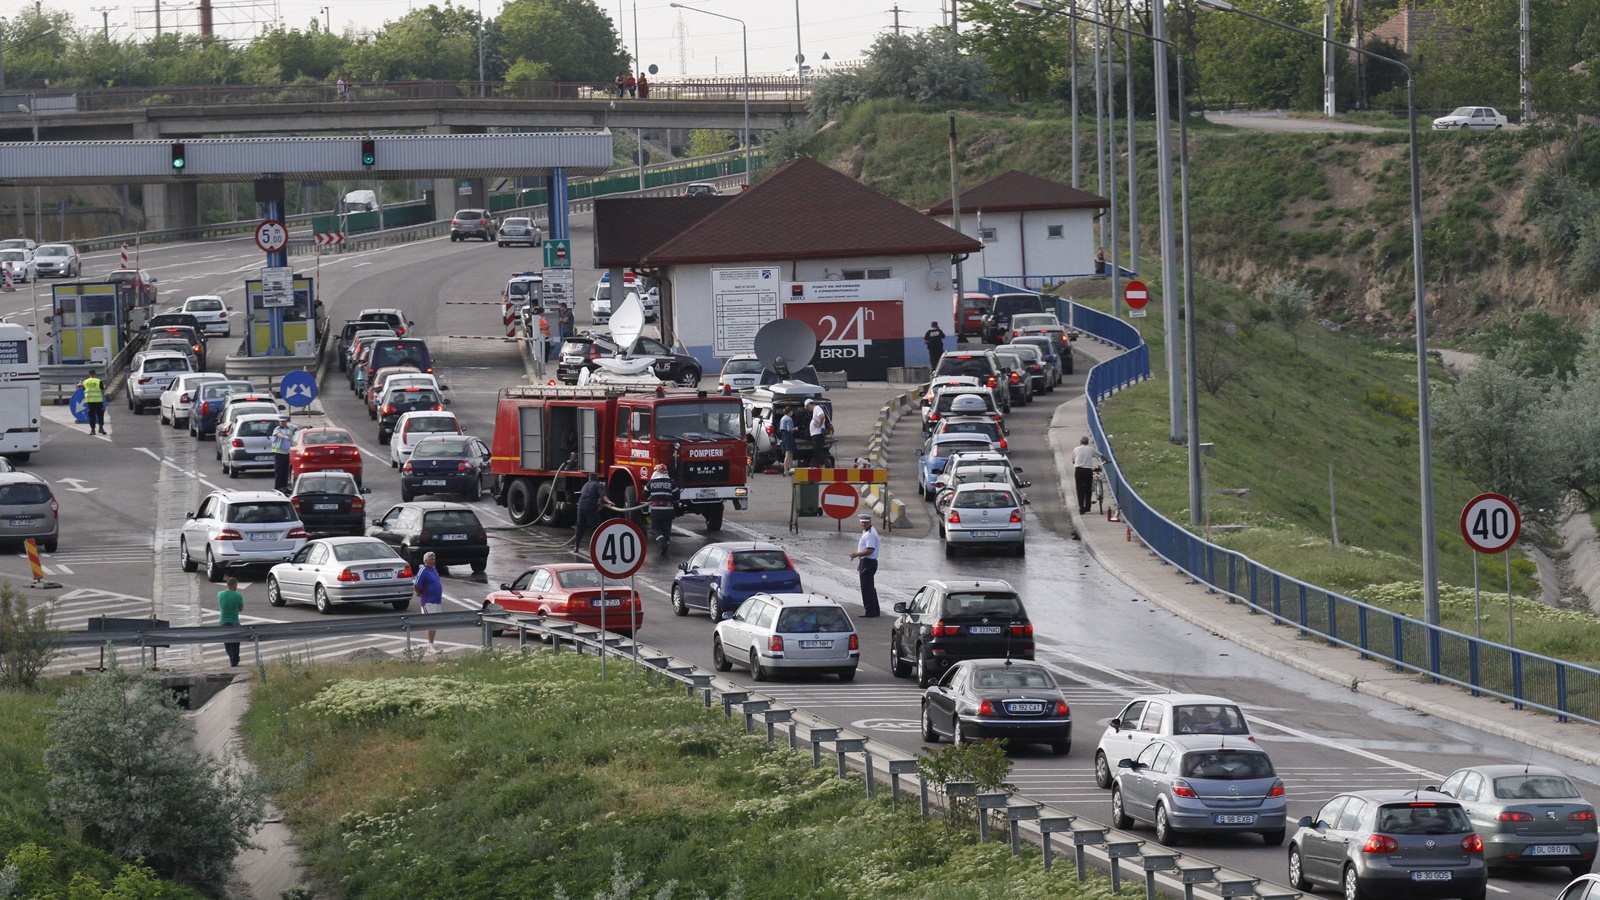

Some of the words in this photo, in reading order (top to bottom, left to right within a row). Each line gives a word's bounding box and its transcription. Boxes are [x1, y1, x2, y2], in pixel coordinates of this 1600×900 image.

[263, 230, 270, 243] 5
[821, 348, 856, 358] BRD
[690, 449, 723, 458] POMPIERII
[1473, 508, 1508, 539] 40
[602, 532, 635, 564] 40
